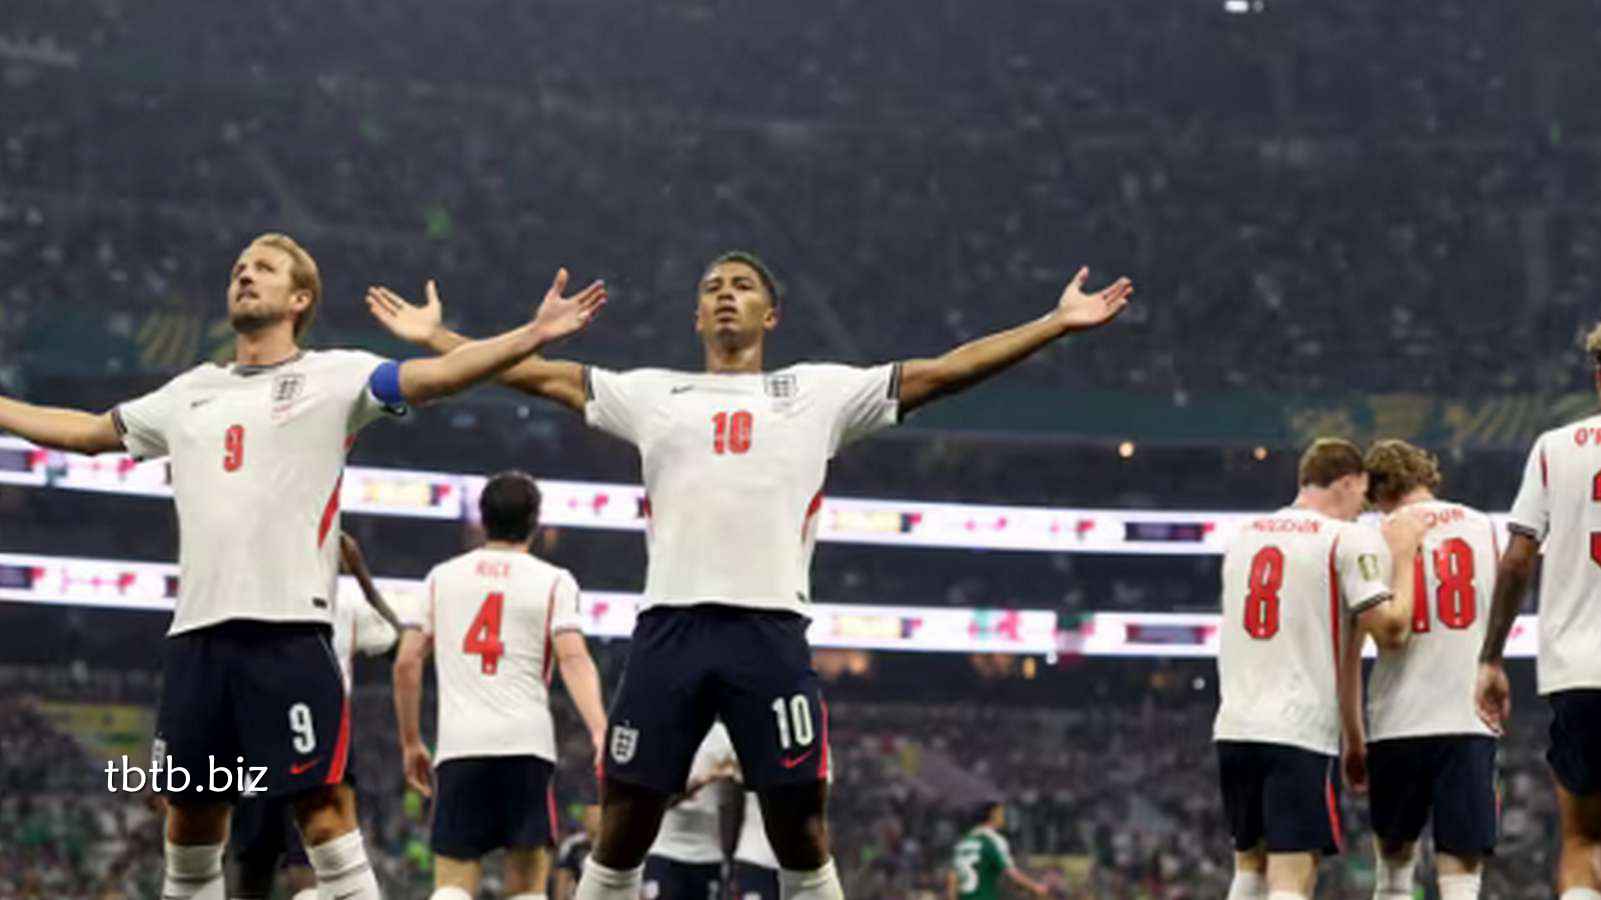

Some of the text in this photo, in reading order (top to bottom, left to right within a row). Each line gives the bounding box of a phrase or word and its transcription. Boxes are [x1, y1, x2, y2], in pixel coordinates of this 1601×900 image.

[223, 424, 245, 472] 9
[711, 410, 753, 454] 10
[1243, 545, 1285, 639] 8
[462, 592, 505, 675] 4
[288, 702, 317, 754] 9
[771, 693, 815, 749] 10
